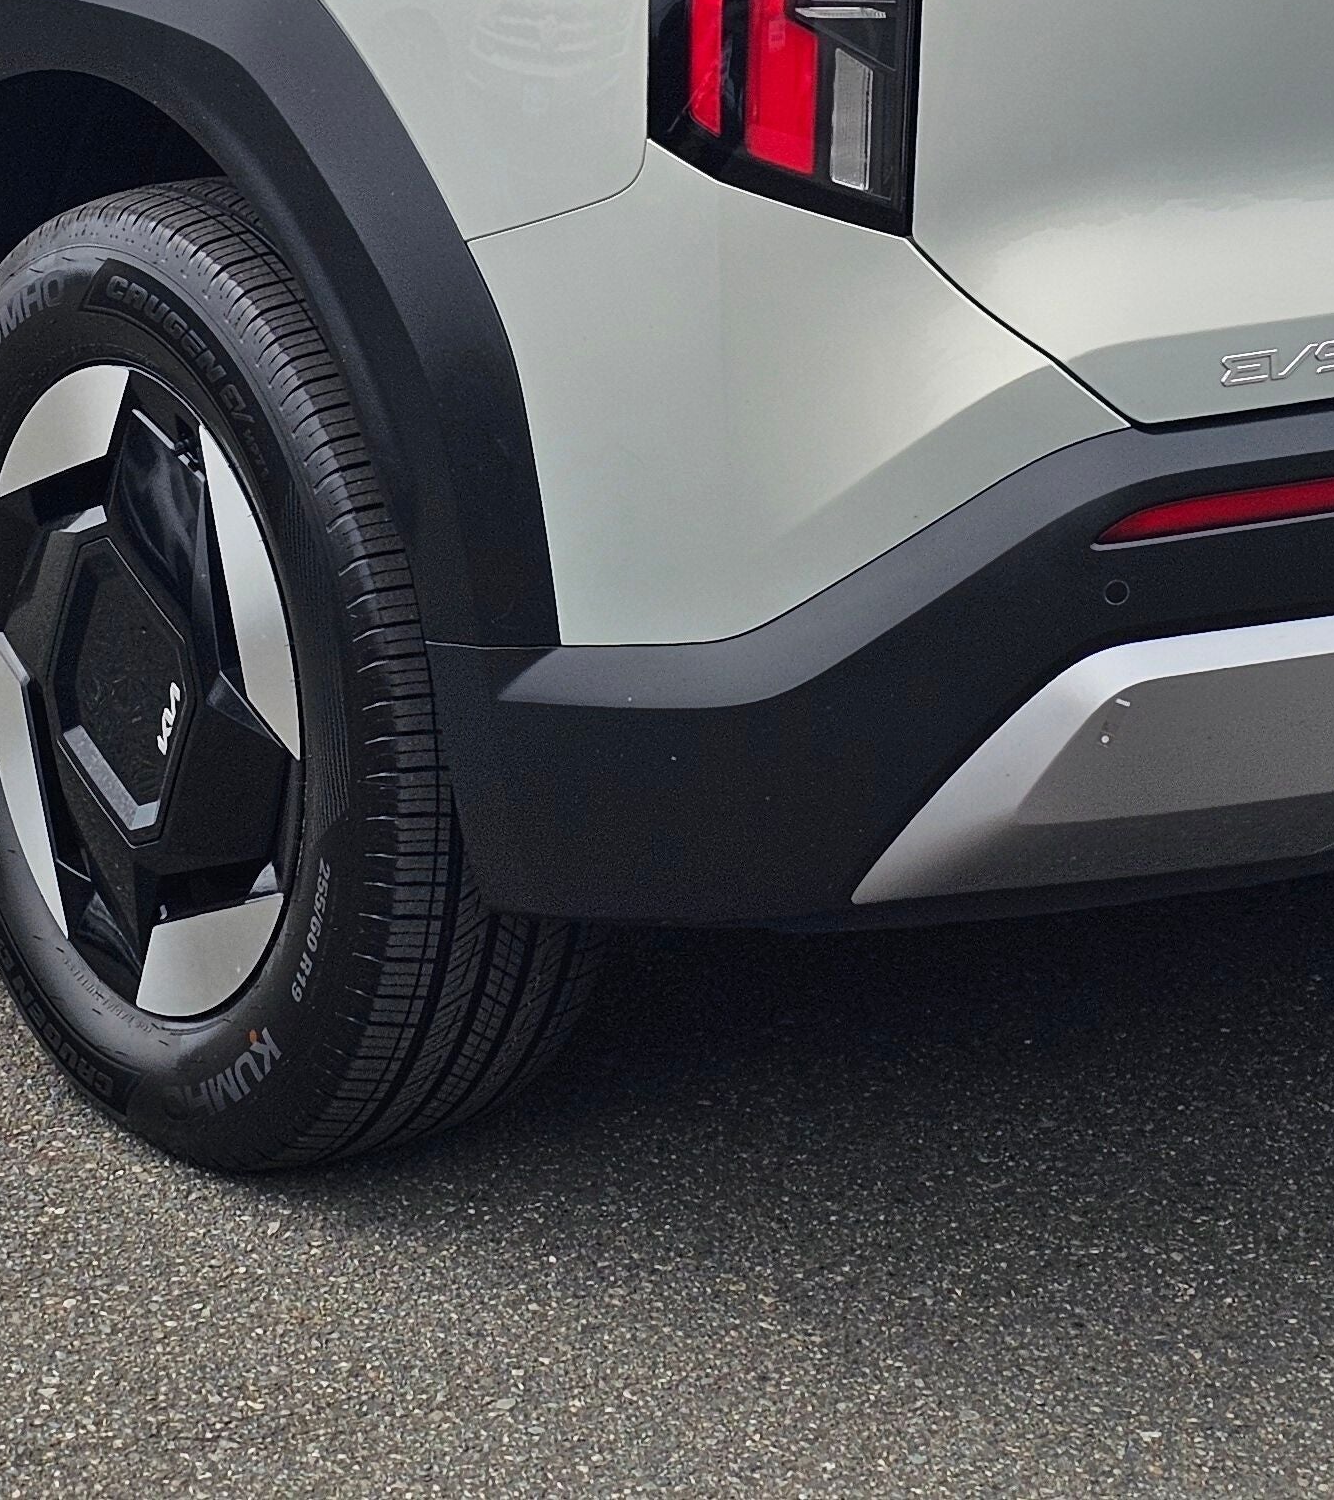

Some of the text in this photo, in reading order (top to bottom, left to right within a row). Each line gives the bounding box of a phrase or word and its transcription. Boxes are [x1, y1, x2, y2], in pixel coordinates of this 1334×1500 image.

[105, 274, 226, 388] CRUGEN
[218, 382, 256, 424] EV
[156, 681, 181, 756] KIA
[290, 856, 332, 1003] 255/60 R19
